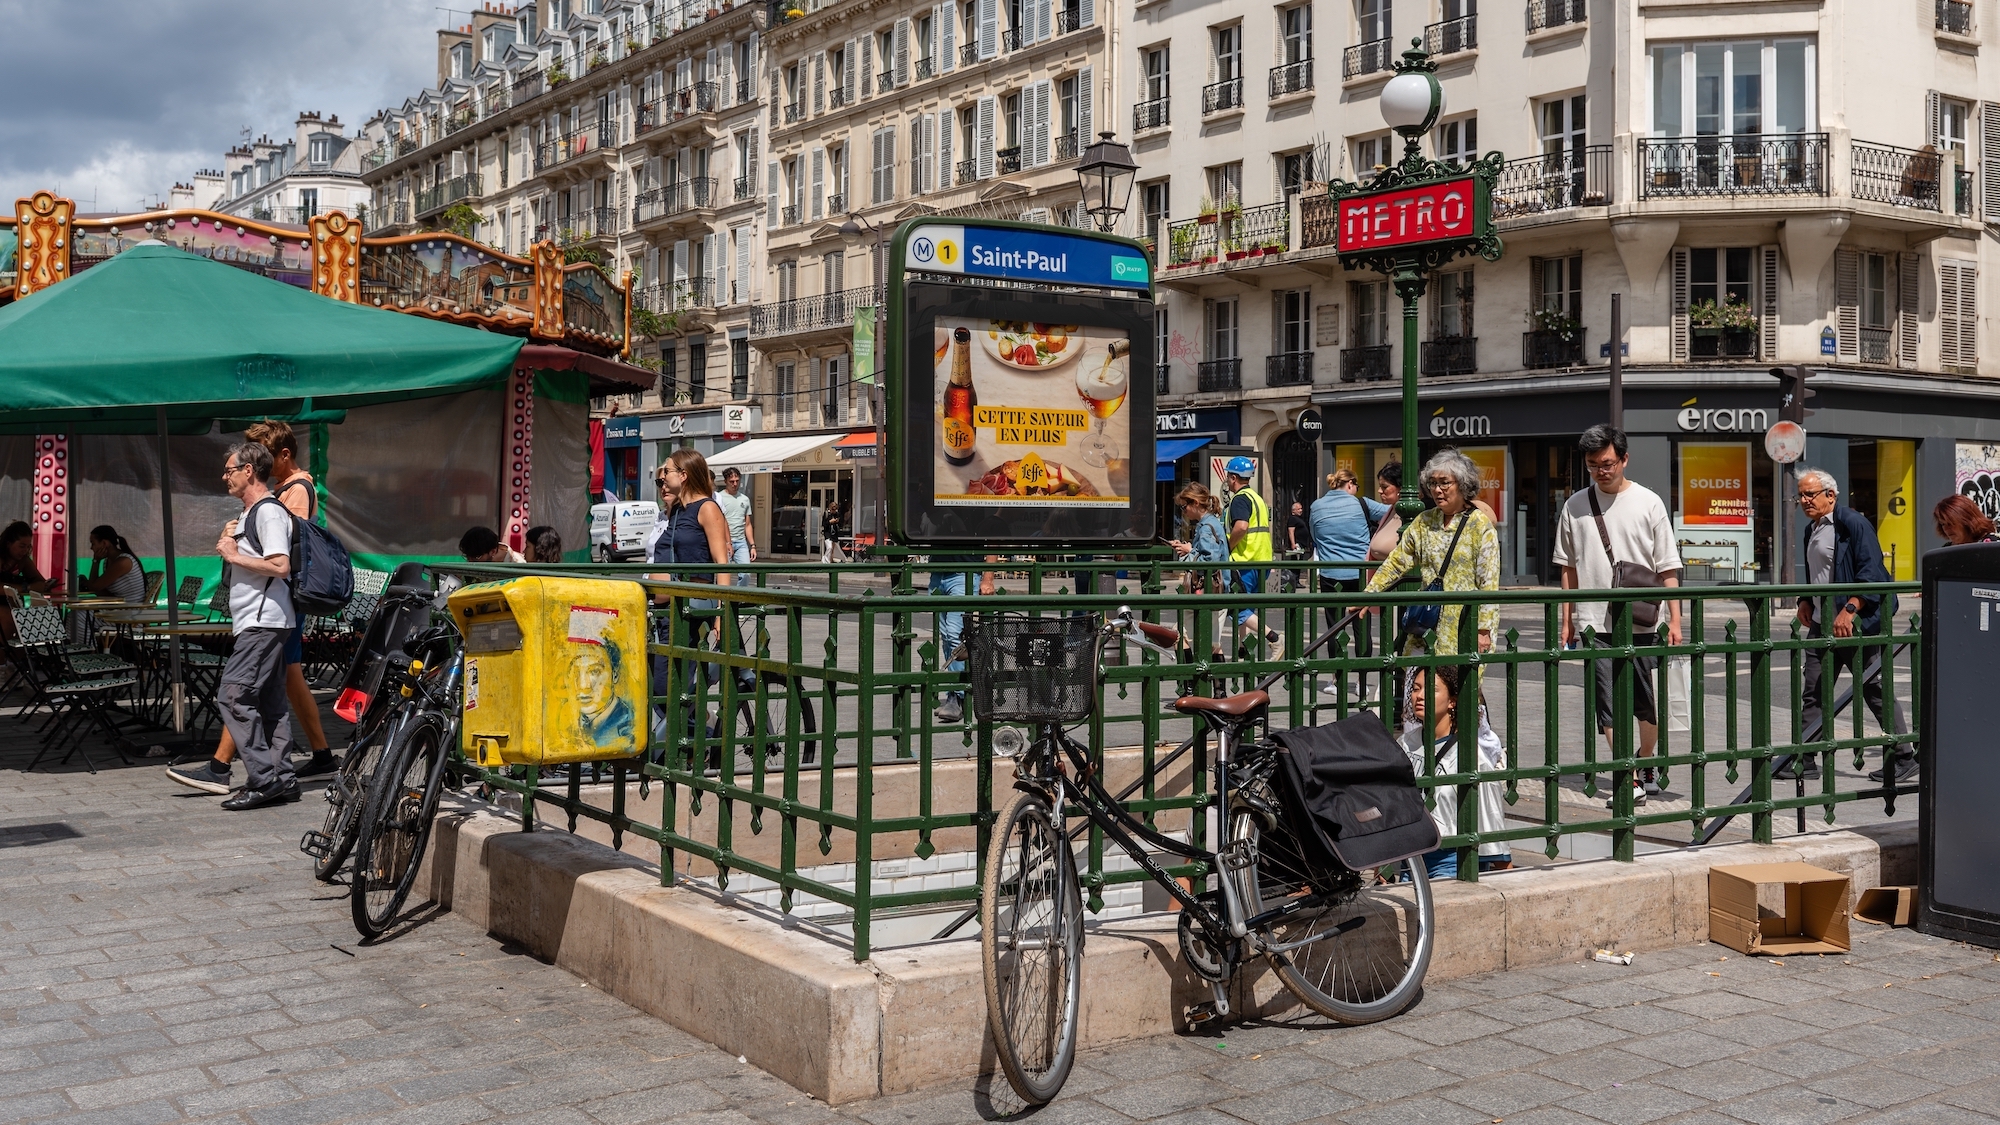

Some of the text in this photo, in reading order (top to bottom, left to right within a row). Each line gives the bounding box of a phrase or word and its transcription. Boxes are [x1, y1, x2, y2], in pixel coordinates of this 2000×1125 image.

[1346, 191, 1464, 244] METRO
[918, 243, 930, 256] M
[944, 245, 951, 260] 1
[971, 245, 1067, 273] Saint-Paul
[978, 410, 1086, 428] CETTE SAVEUR
[1156, 413, 1196, 430] PTICIEN
[1430, 406, 1491, 437] éram
[1677, 397, 1768, 431] éram
[1302, 418, 1322, 430] éram
[944, 426, 969, 447] Leffe
[1000, 428, 1020, 442] EN
[1022, 464, 1044, 484] Leffe
[1479, 480, 1500, 489] LDES
[1690, 478, 1741, 489] SOLDES
[1711, 498, 1750, 507] DERNIÈRE
[1708, 506, 1755, 516] DÉMARQUE
